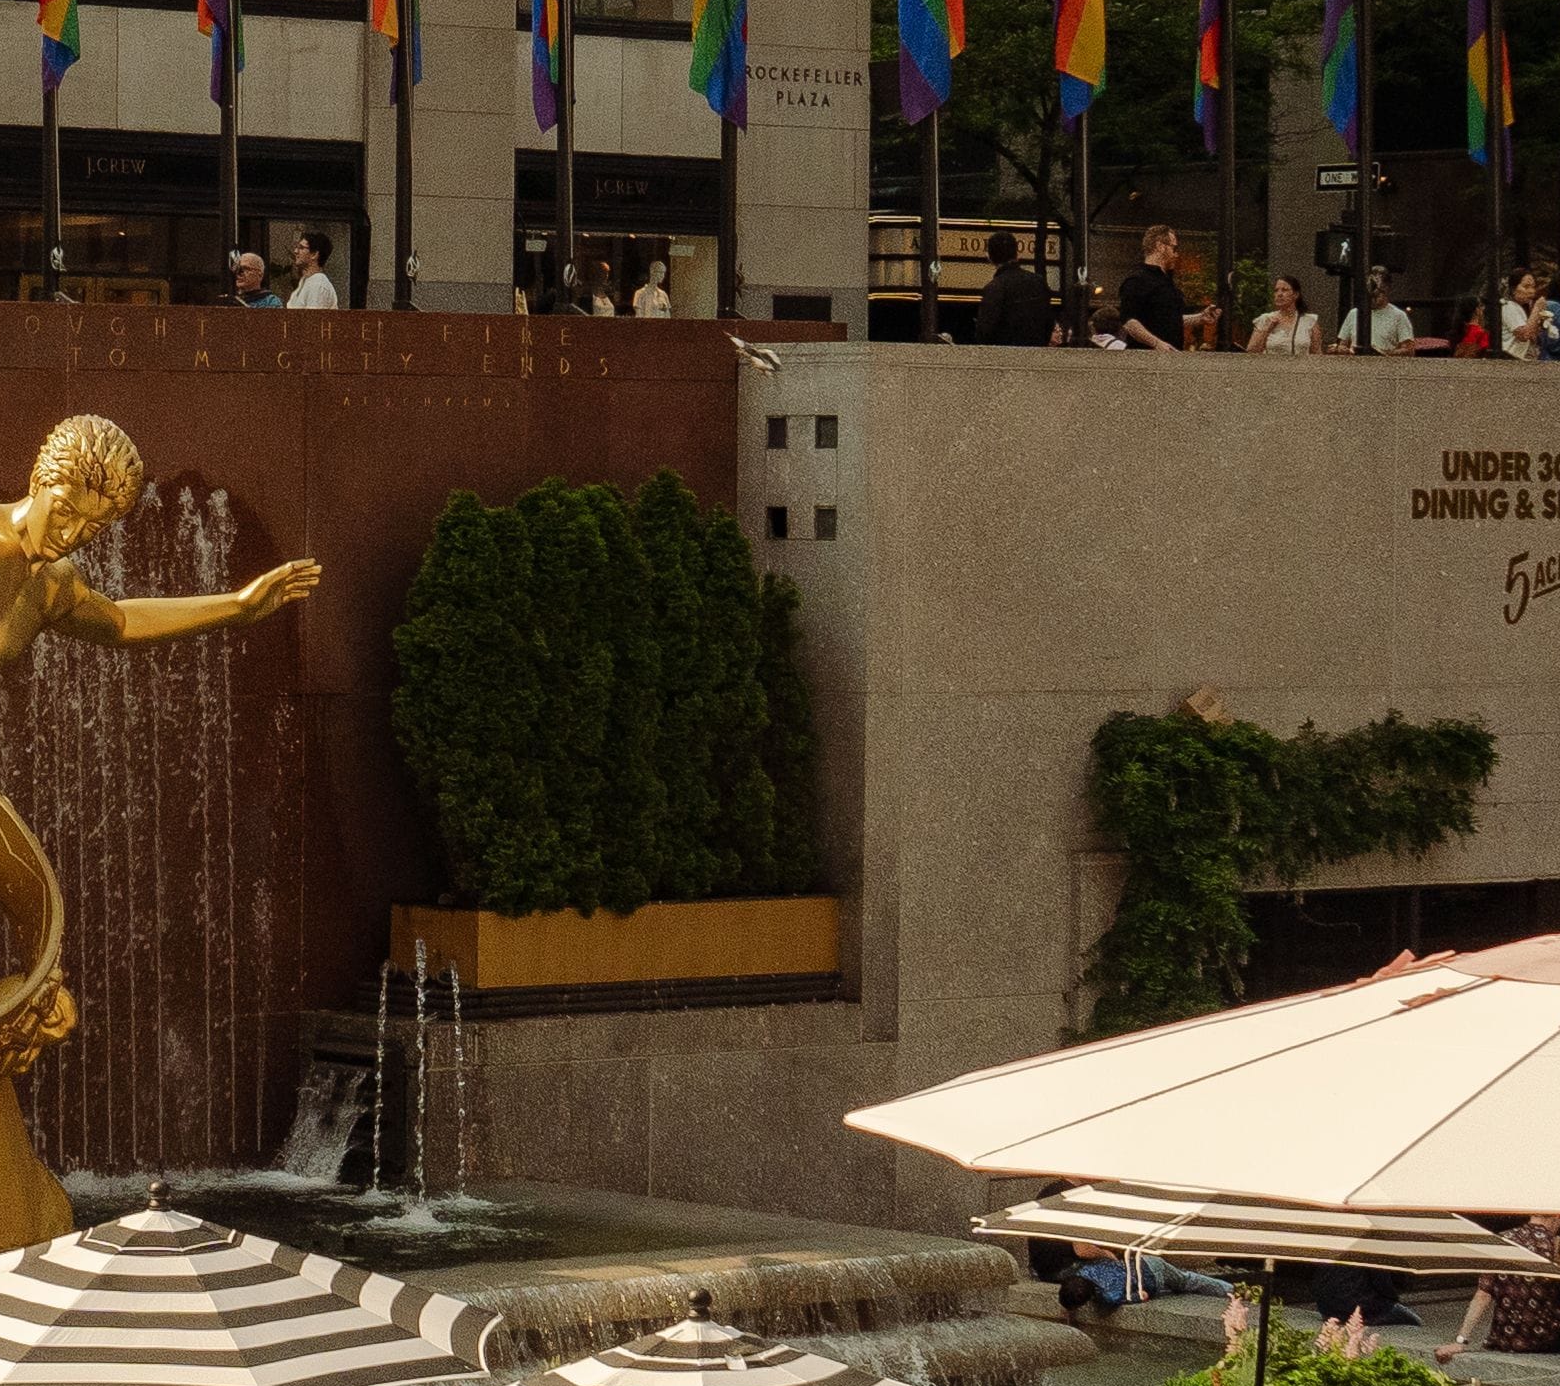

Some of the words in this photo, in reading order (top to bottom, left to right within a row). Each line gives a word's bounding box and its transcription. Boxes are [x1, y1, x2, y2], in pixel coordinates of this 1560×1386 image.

[746, 65, 862, 86] ROCKEFELLER
[776, 90, 830, 108] PLAZA
[281, 320, 373, 343] THE
[443, 324, 572, 347] FIRE
[70, 346, 128, 368] TO
[194, 350, 414, 373] MIGHTY
[482, 352, 610, 377] ENDS
[1442, 451, 1532, 482] UNDER
[1411, 489, 1510, 520] DINING
[1515, 489, 1536, 520] &
[1503, 551, 1530, 625] 5
